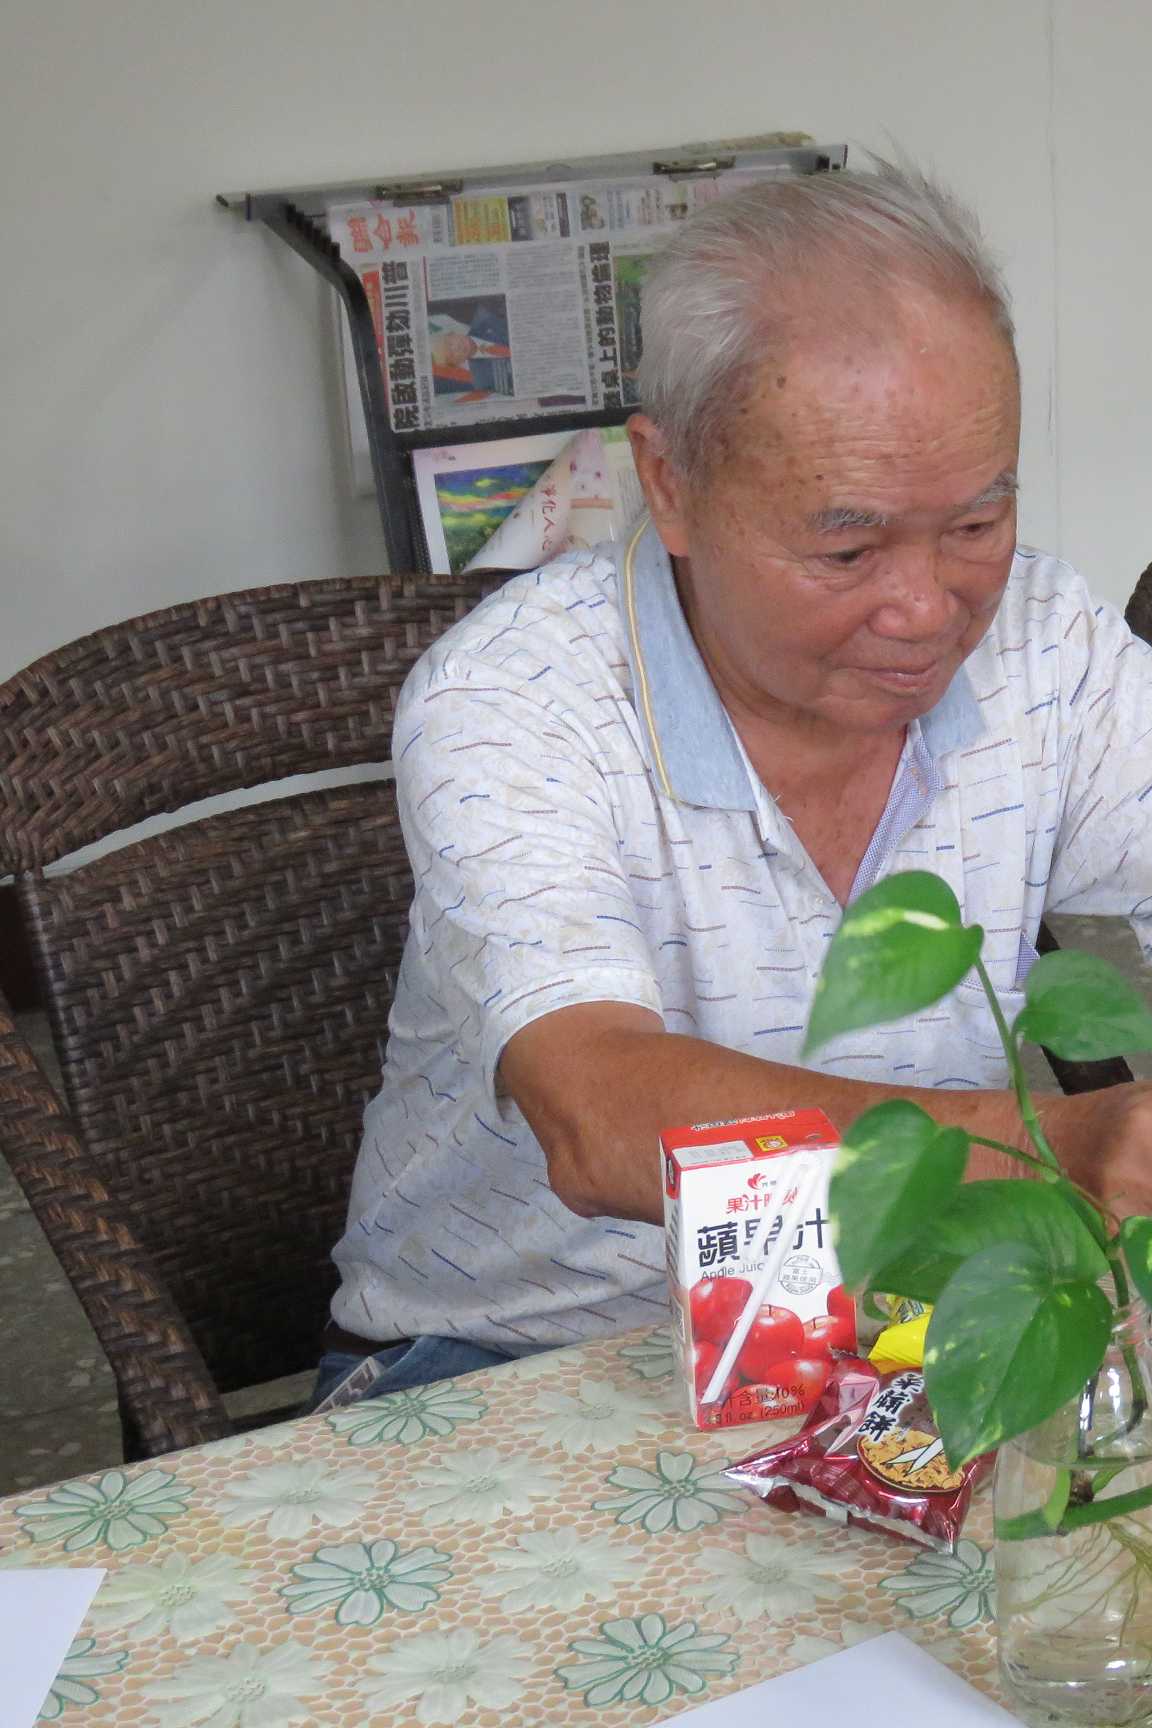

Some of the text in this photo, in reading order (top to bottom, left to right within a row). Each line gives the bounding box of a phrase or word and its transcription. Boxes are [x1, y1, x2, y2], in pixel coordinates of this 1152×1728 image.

[347, 212, 422, 253] 聯合報
[701, 1261, 766, 1282] Apple Juic
